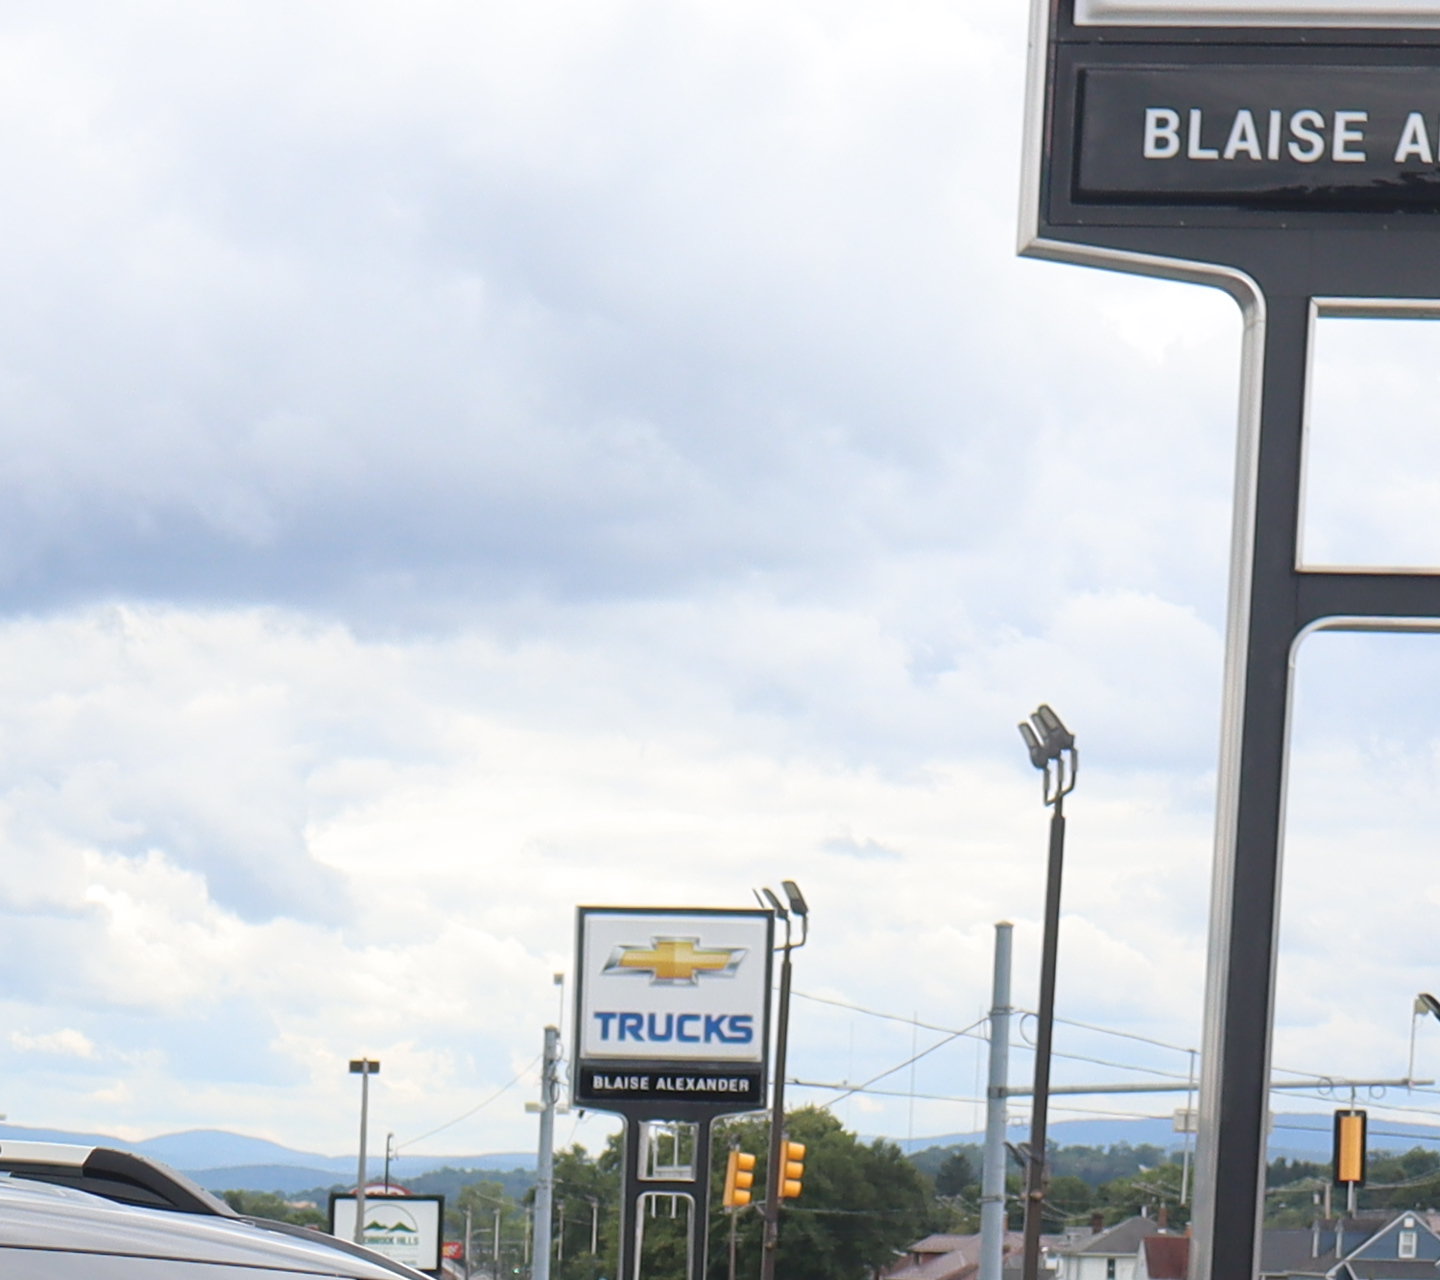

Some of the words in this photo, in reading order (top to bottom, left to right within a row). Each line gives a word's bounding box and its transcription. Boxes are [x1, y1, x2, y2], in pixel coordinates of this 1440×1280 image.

[1143, 107, 1369, 163] BLAISE
[593, 1011, 754, 1045] TRUCKS
[592, 1075, 650, 1091] BLAISE
[655, 1076, 751, 1093] ALEXANDER
